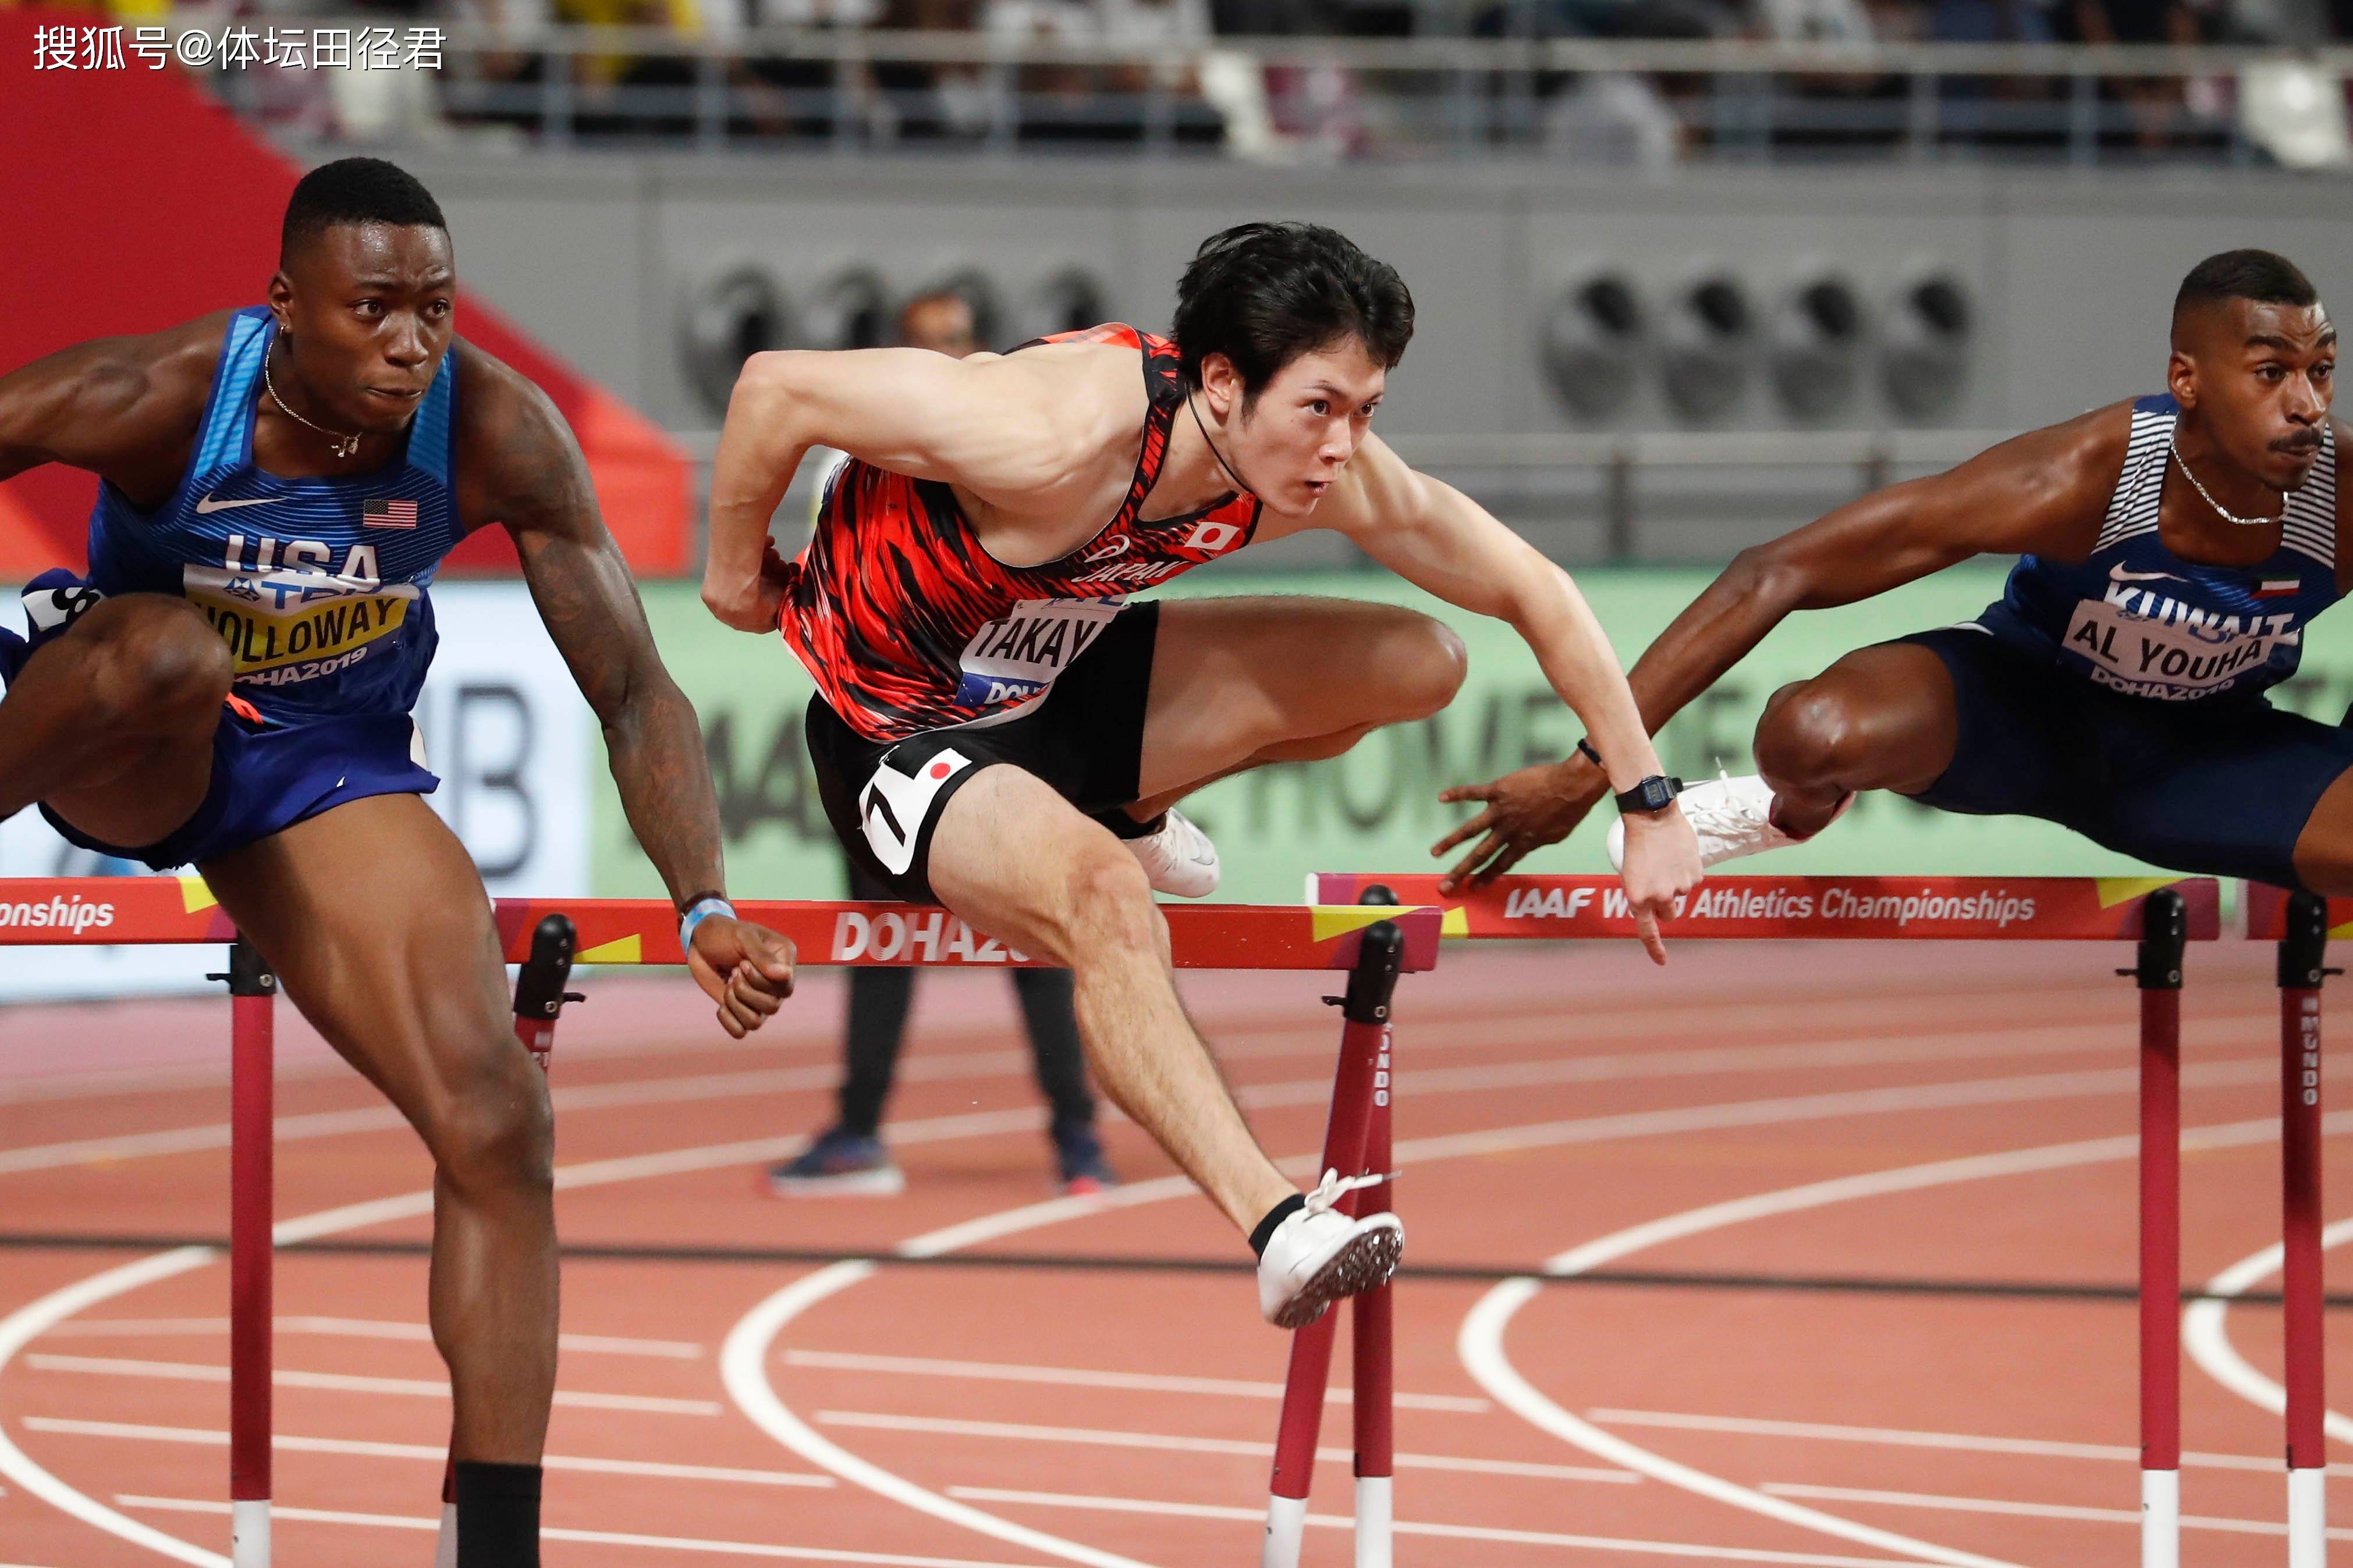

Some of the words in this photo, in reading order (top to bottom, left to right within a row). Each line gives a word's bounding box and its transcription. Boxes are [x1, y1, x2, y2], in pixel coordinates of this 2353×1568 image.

[224, 534, 381, 585] USA
[1071, 560, 1187, 582] JAPAN
[234, 646, 368, 687] OHA2019
[2073, 619, 2118, 663] AL
[2139, 638, 2262, 681] YOUHA
[865, 783, 906, 847] 7
[1504, 887, 1596, 919] IAAF
[1690, 887, 1813, 920] Athletics
[1820, 887, 2036, 927] Championships
[831, 912, 1031, 962] DOHA2
[1374, 1021, 1393, 1107] ONDO
